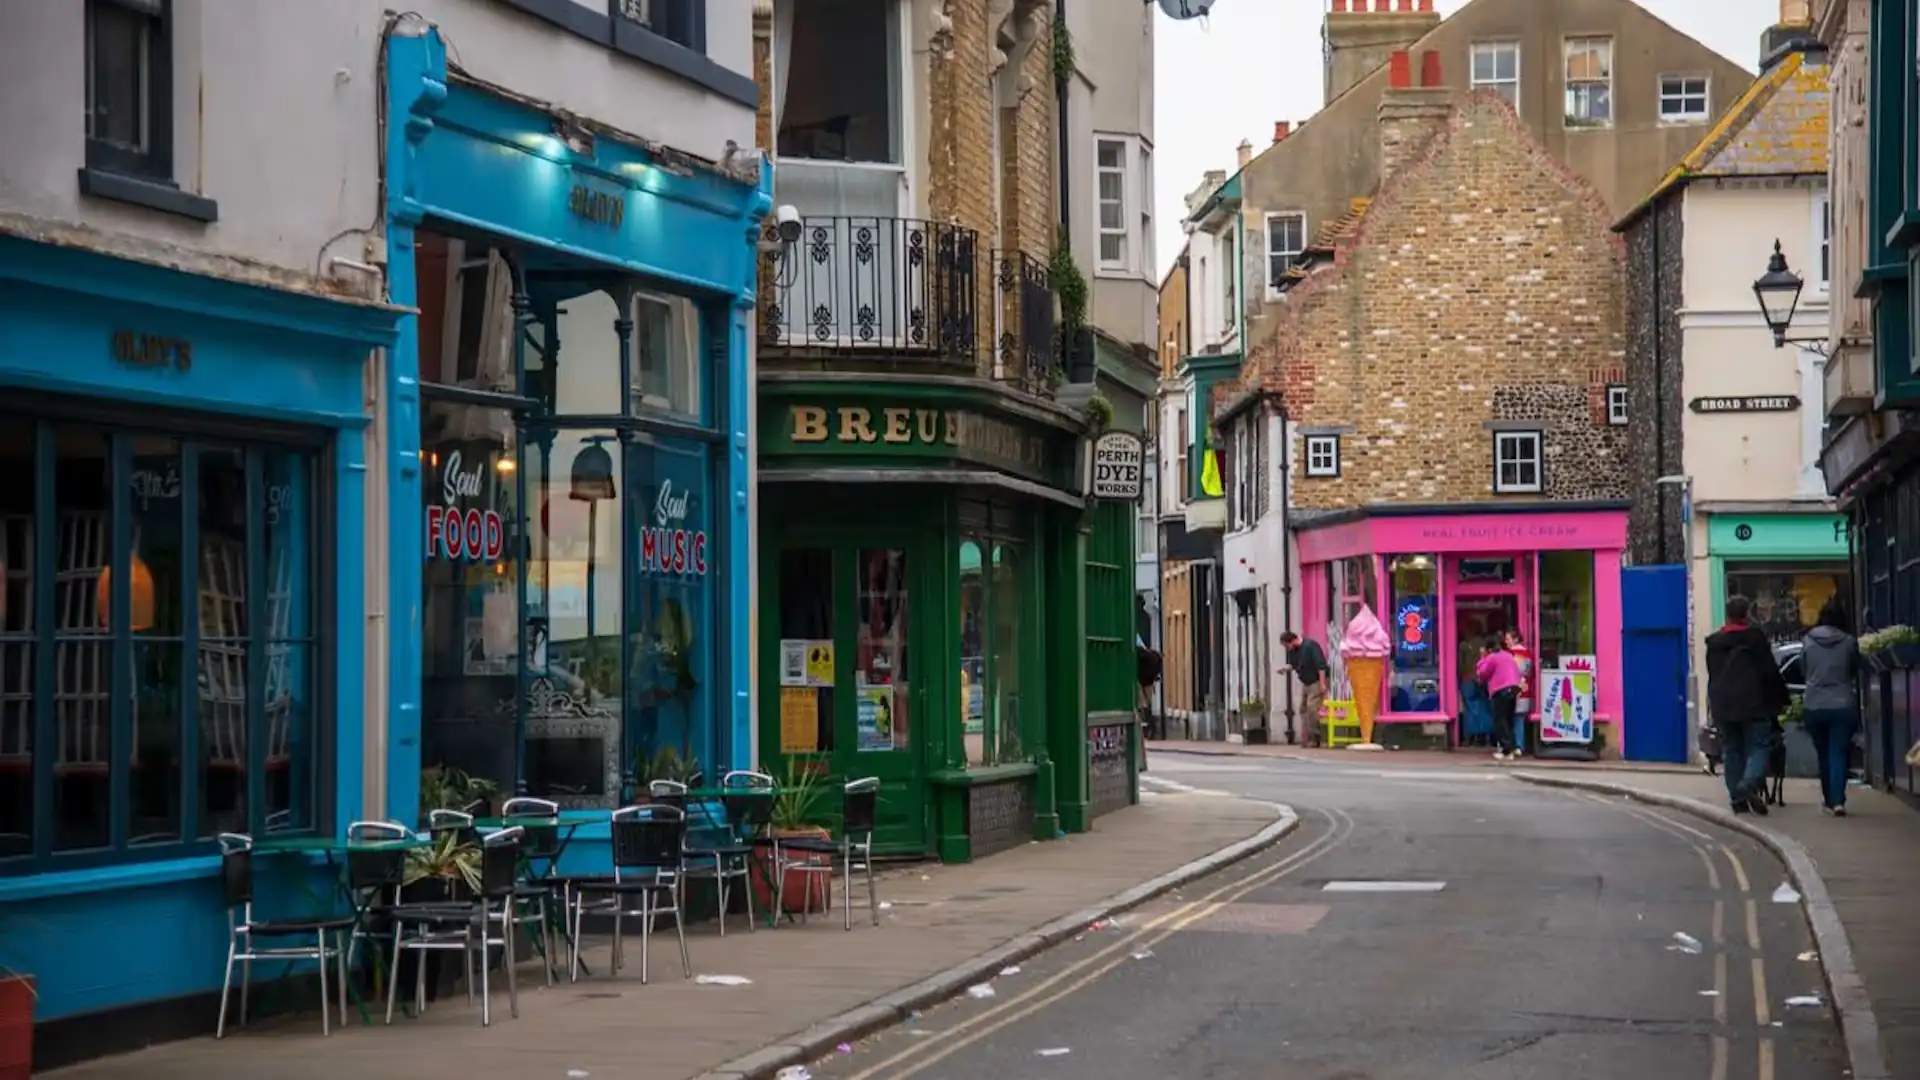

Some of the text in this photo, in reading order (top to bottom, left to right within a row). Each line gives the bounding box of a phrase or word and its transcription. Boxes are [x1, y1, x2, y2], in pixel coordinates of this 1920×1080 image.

[1701, 398, 1790, 409] BROAD STREET
[1098, 450, 1139, 461] PERTH
[443, 450, 484, 505] Soul
[1097, 465, 1137, 481] DYE
[1096, 484, 1137, 493] WORKS
[655, 479, 689, 526] Soul
[427, 505, 503, 560] FOOD
[1423, 525, 1577, 538] REAL FRUIT ICE CREAM
[640, 525, 708, 576] MUSIC
